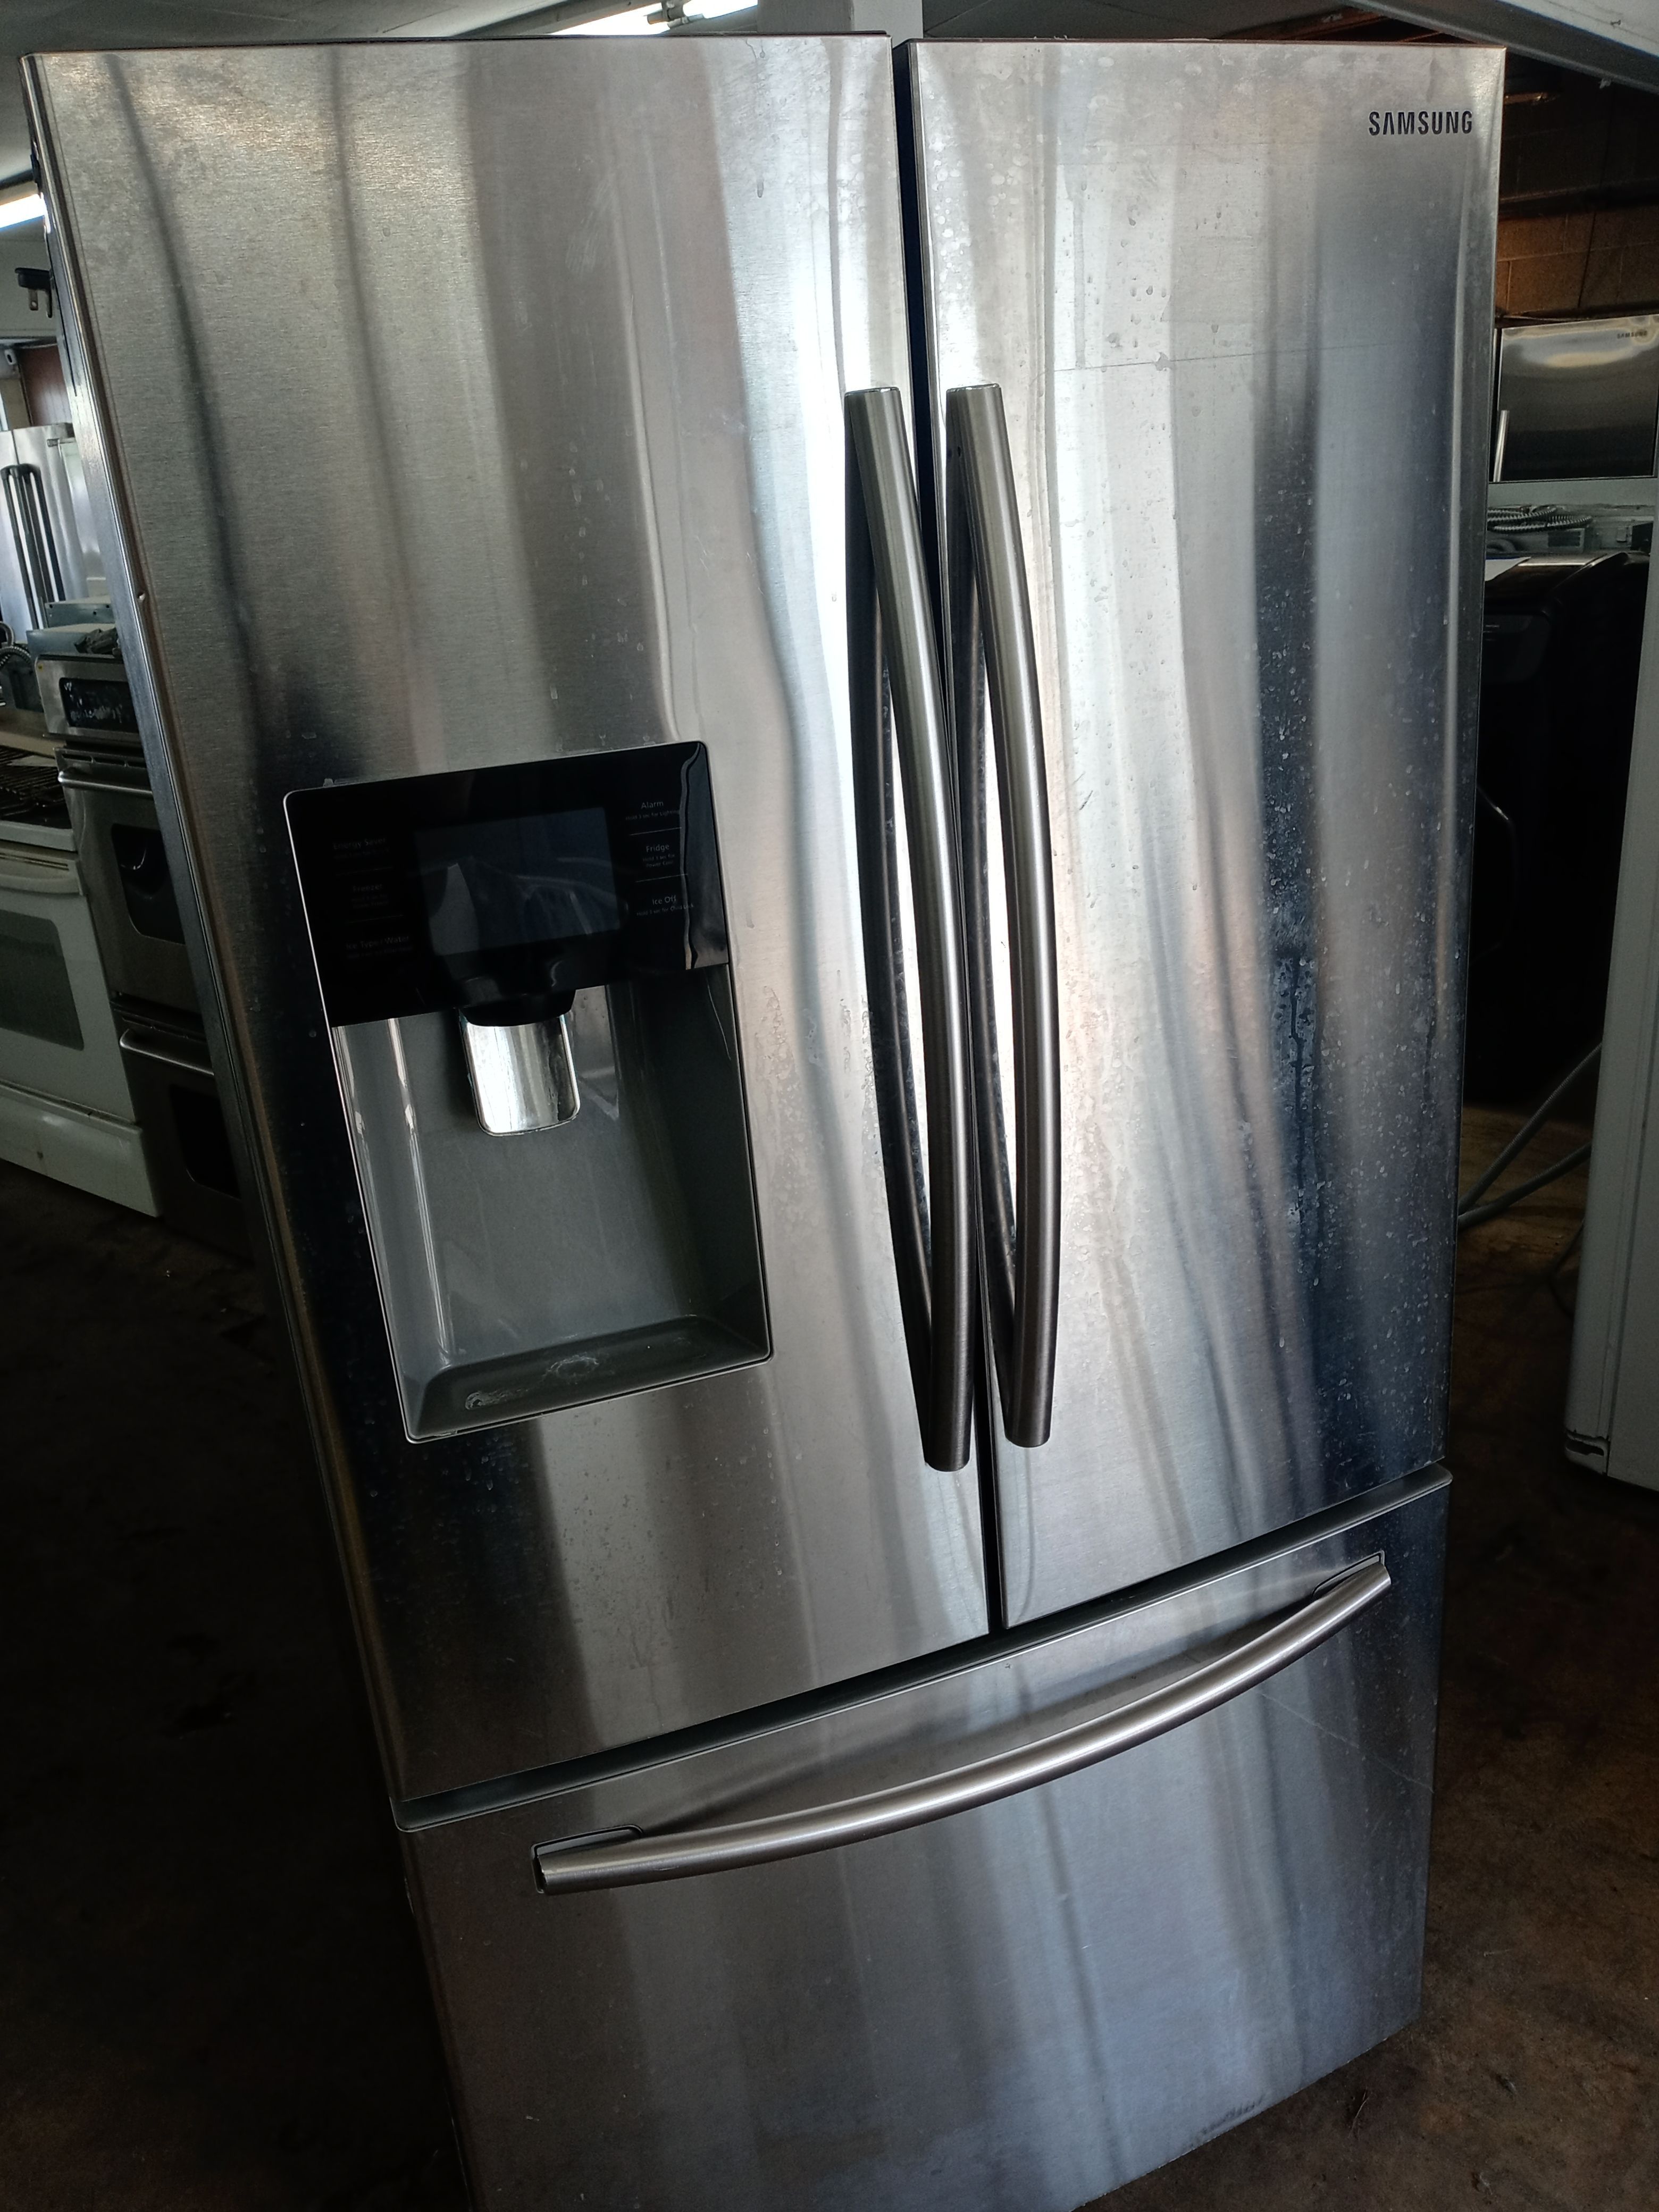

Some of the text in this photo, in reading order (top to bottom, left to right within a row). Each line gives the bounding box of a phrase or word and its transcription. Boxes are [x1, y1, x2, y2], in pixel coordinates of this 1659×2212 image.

[1369, 111, 1472, 136] SAMSUNG
[646, 843, 670, 852] Fridge
[352, 883, 383, 894] Freezer
[664, 894, 676, 903] Off
[384, 935, 409, 945] Water
